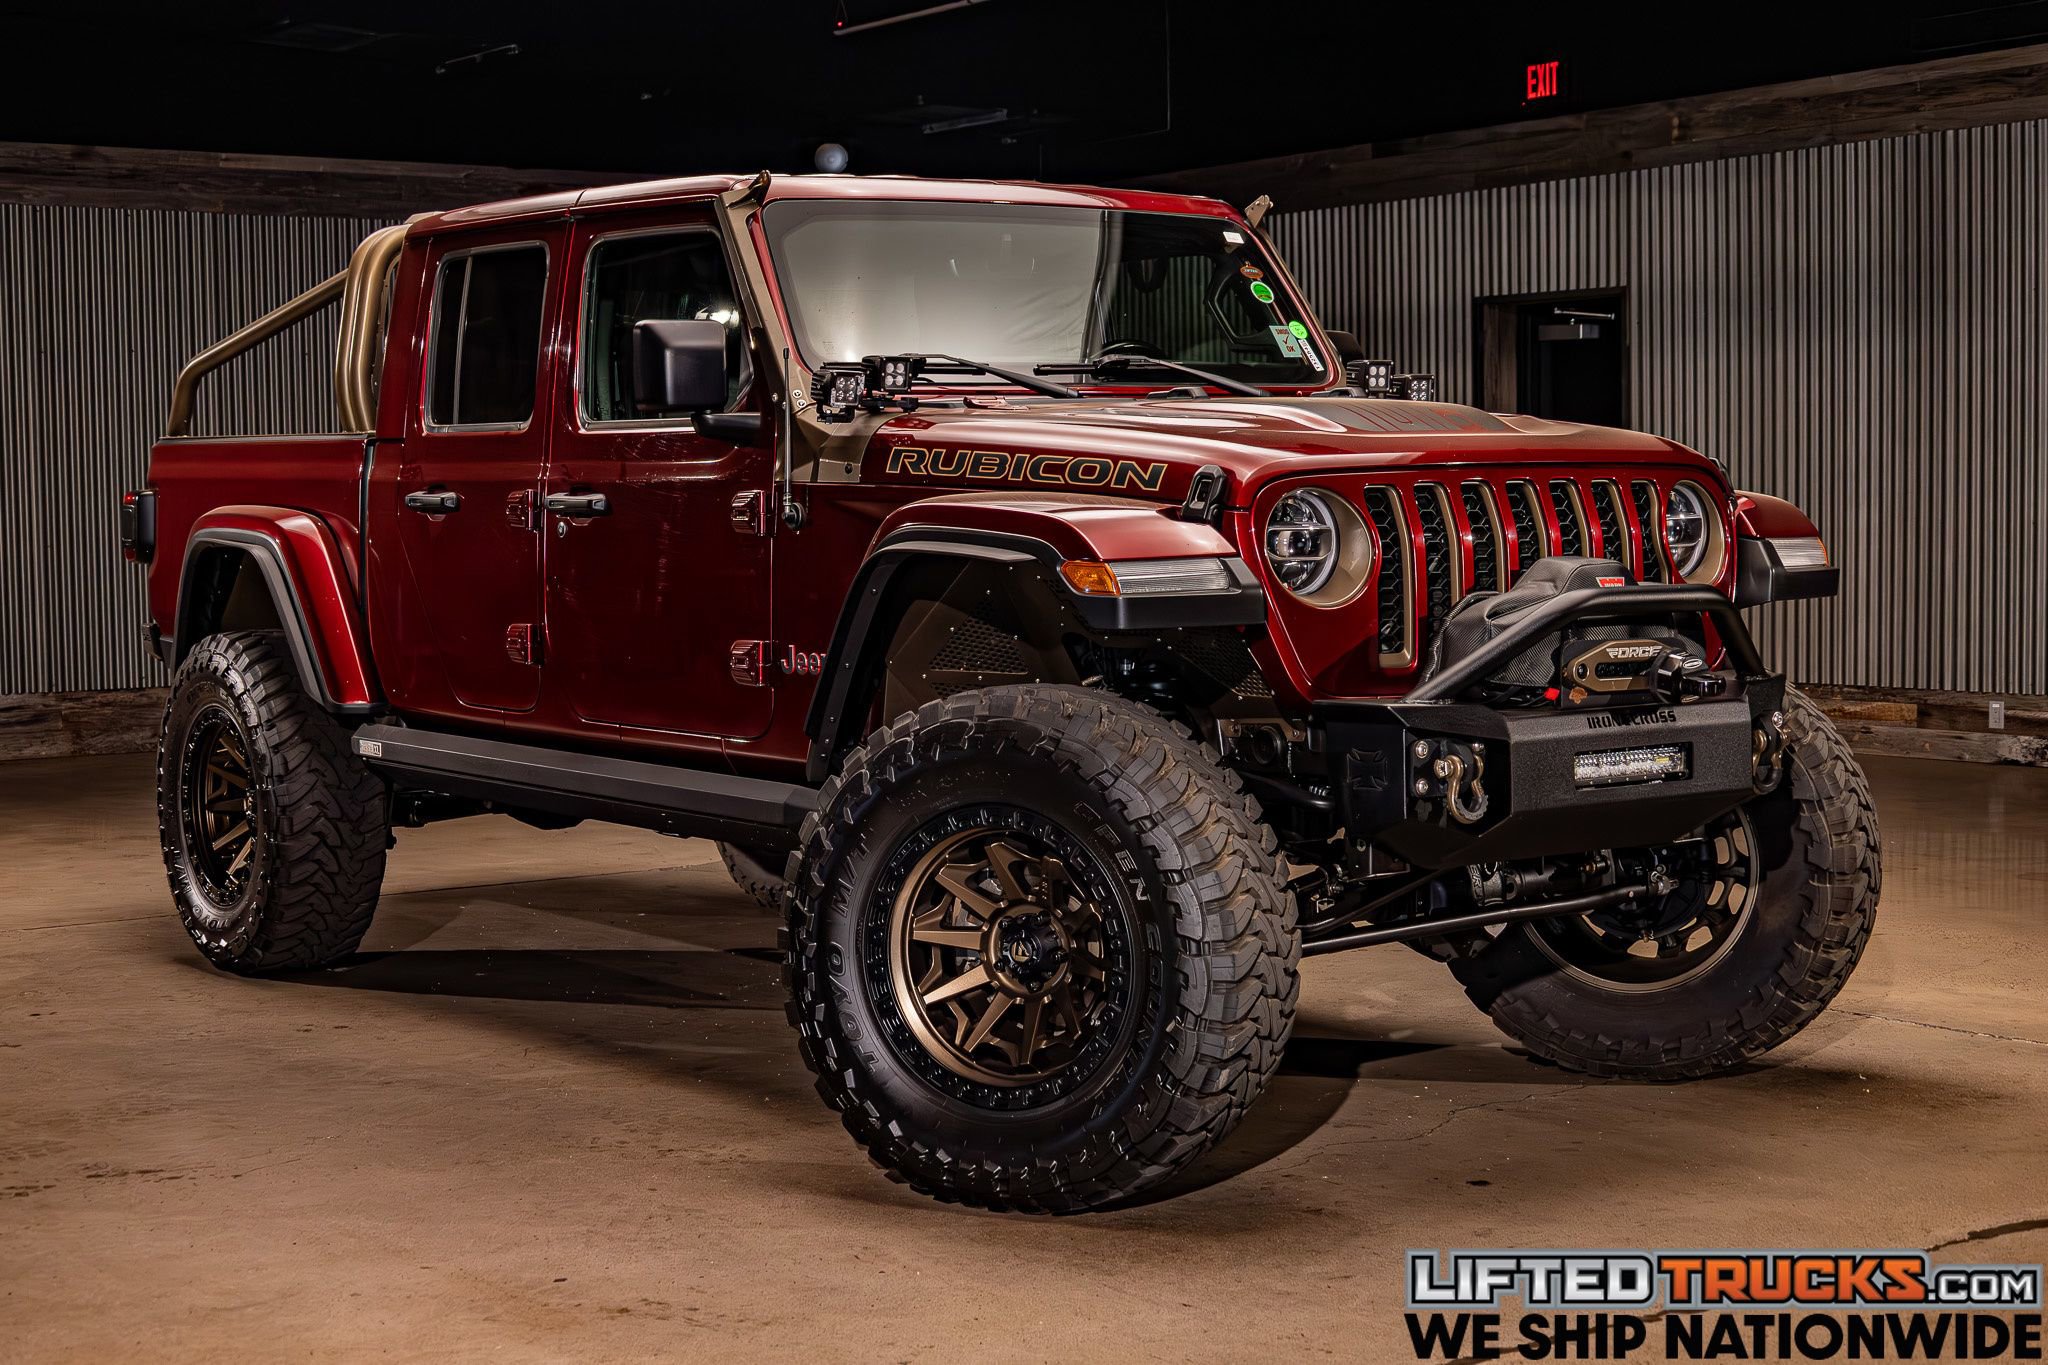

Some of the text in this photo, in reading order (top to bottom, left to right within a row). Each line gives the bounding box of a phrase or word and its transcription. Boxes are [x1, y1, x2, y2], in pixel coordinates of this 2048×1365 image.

[1527, 61, 1559, 99] EXIT
[886, 447, 1168, 491] RUBICON
[1606, 645, 1663, 659] FORCE
[1587, 710, 1677, 729] IRON CROSS
[1072, 801, 1151, 901] OPEN
[827, 940, 880, 1073] TOYO
